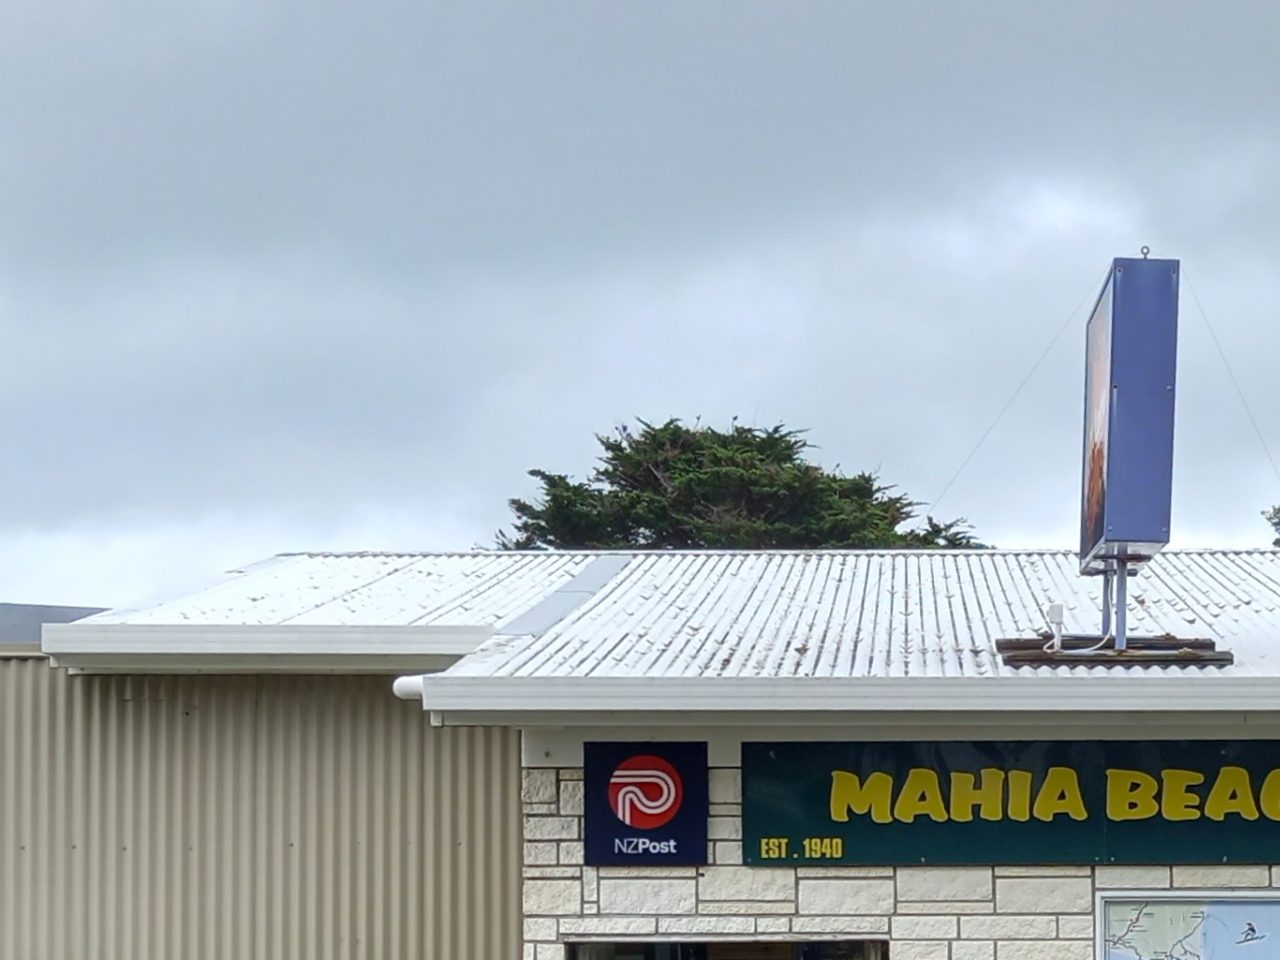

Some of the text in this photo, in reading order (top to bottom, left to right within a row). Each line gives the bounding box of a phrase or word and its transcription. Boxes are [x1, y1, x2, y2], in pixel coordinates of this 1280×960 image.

[830, 766, 1088, 824] MAHIA
[614, 838, 677, 854] NZPost
[803, 838, 843, 859] 1940
